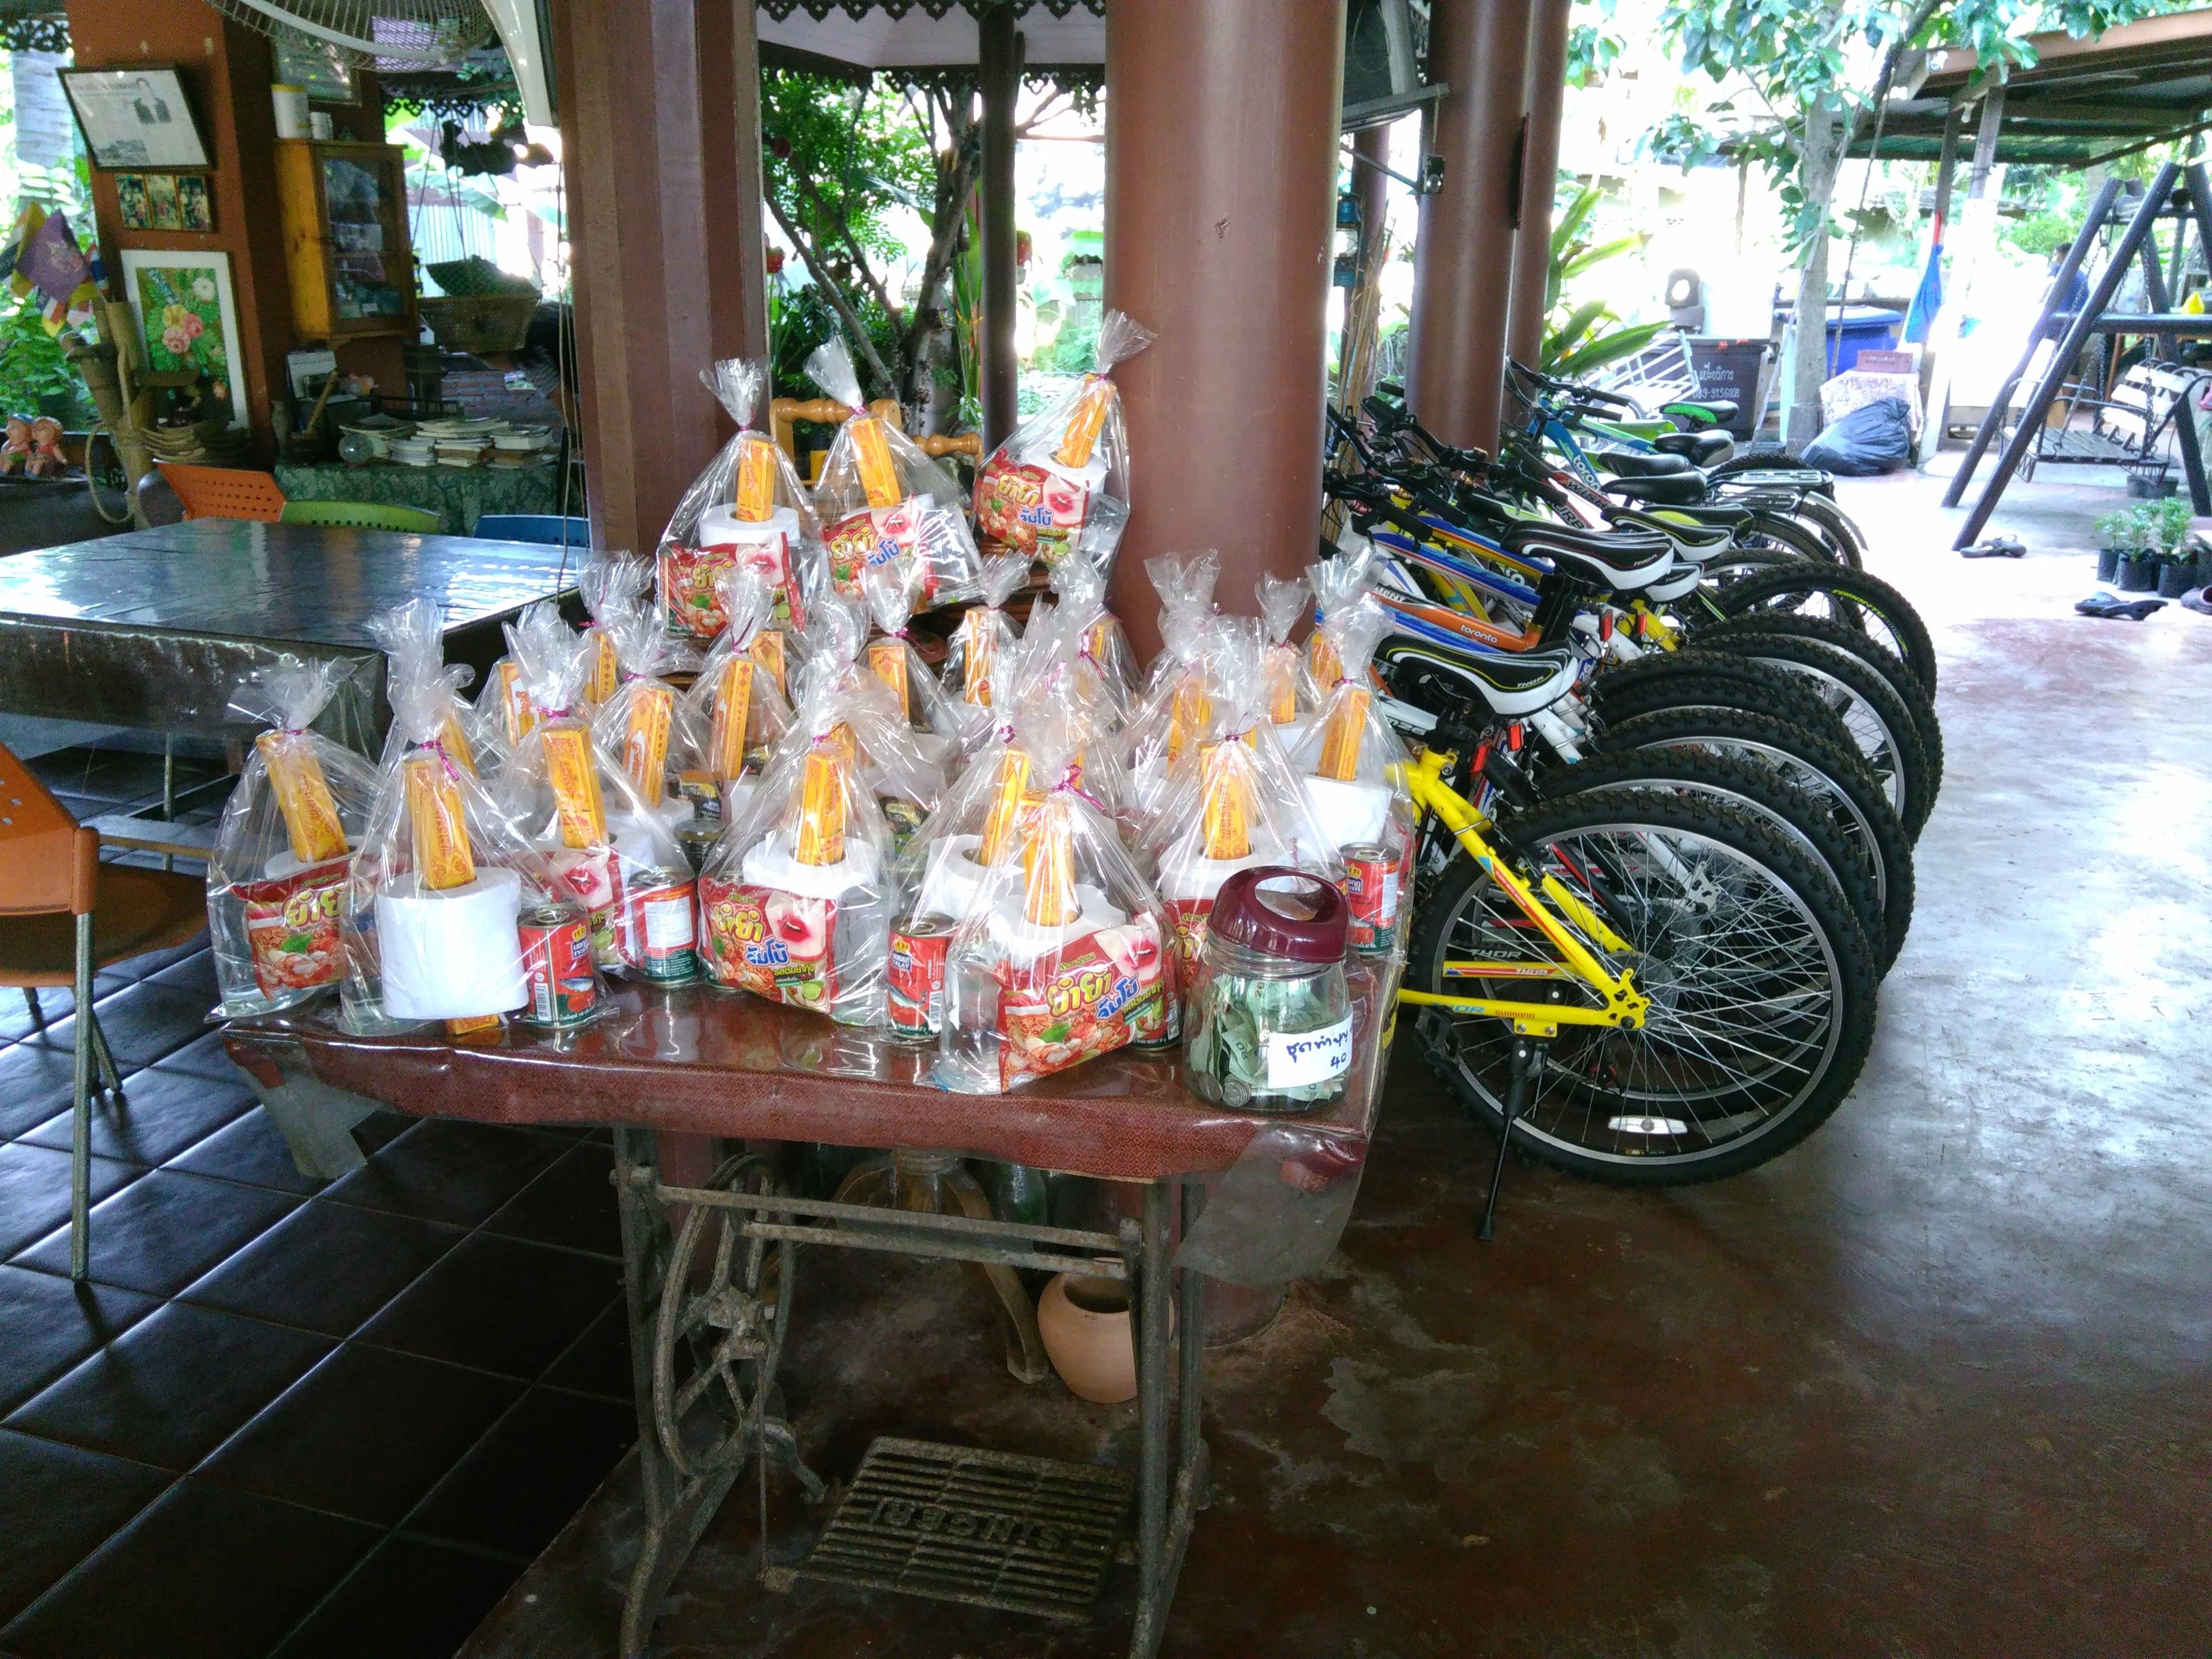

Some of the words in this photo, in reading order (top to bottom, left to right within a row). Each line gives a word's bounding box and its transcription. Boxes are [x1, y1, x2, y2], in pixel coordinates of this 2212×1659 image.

[1460, 624, 1498, 644] toronto
[1517, 675, 1544, 688] THOR
[746, 937, 789, 966] จัมโบ้
[1469, 948, 1522, 960] THOR
[1048, 963, 1113, 1017] ยำยำ
[1495, 1009, 1535, 1019] SHIMANO
[1330, 1052, 1347, 1069] 40
